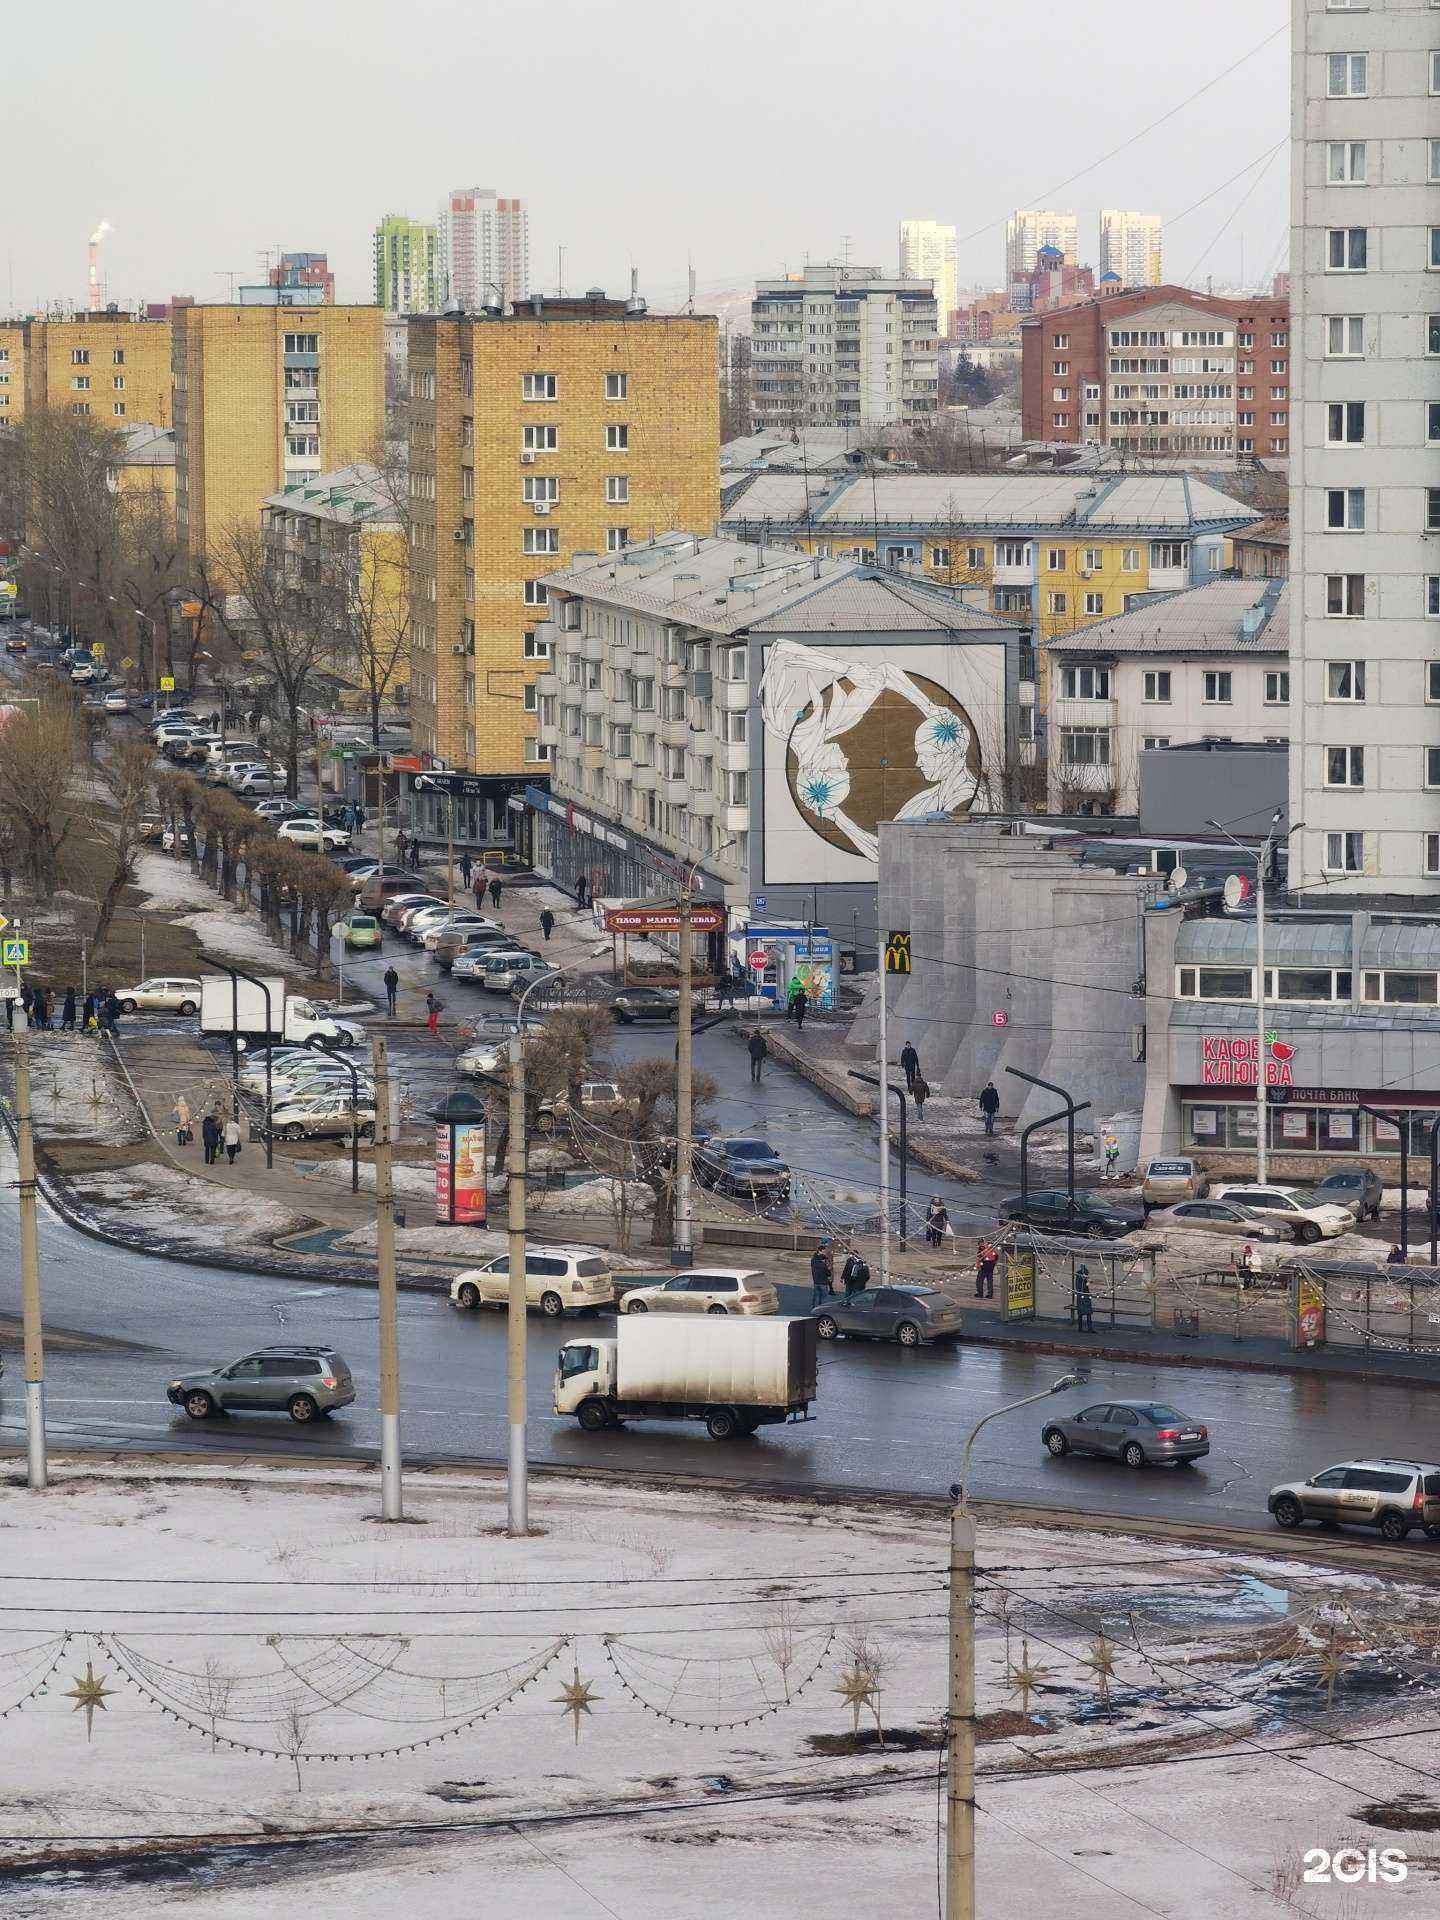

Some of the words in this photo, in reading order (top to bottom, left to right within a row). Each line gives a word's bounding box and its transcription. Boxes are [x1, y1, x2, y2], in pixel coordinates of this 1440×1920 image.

[1202, 1035, 1260, 1061] КАФЕ
[1292, 1089, 1327, 1100] ПОЧТА
[1330, 1090, 1360, 1101] БАНК
